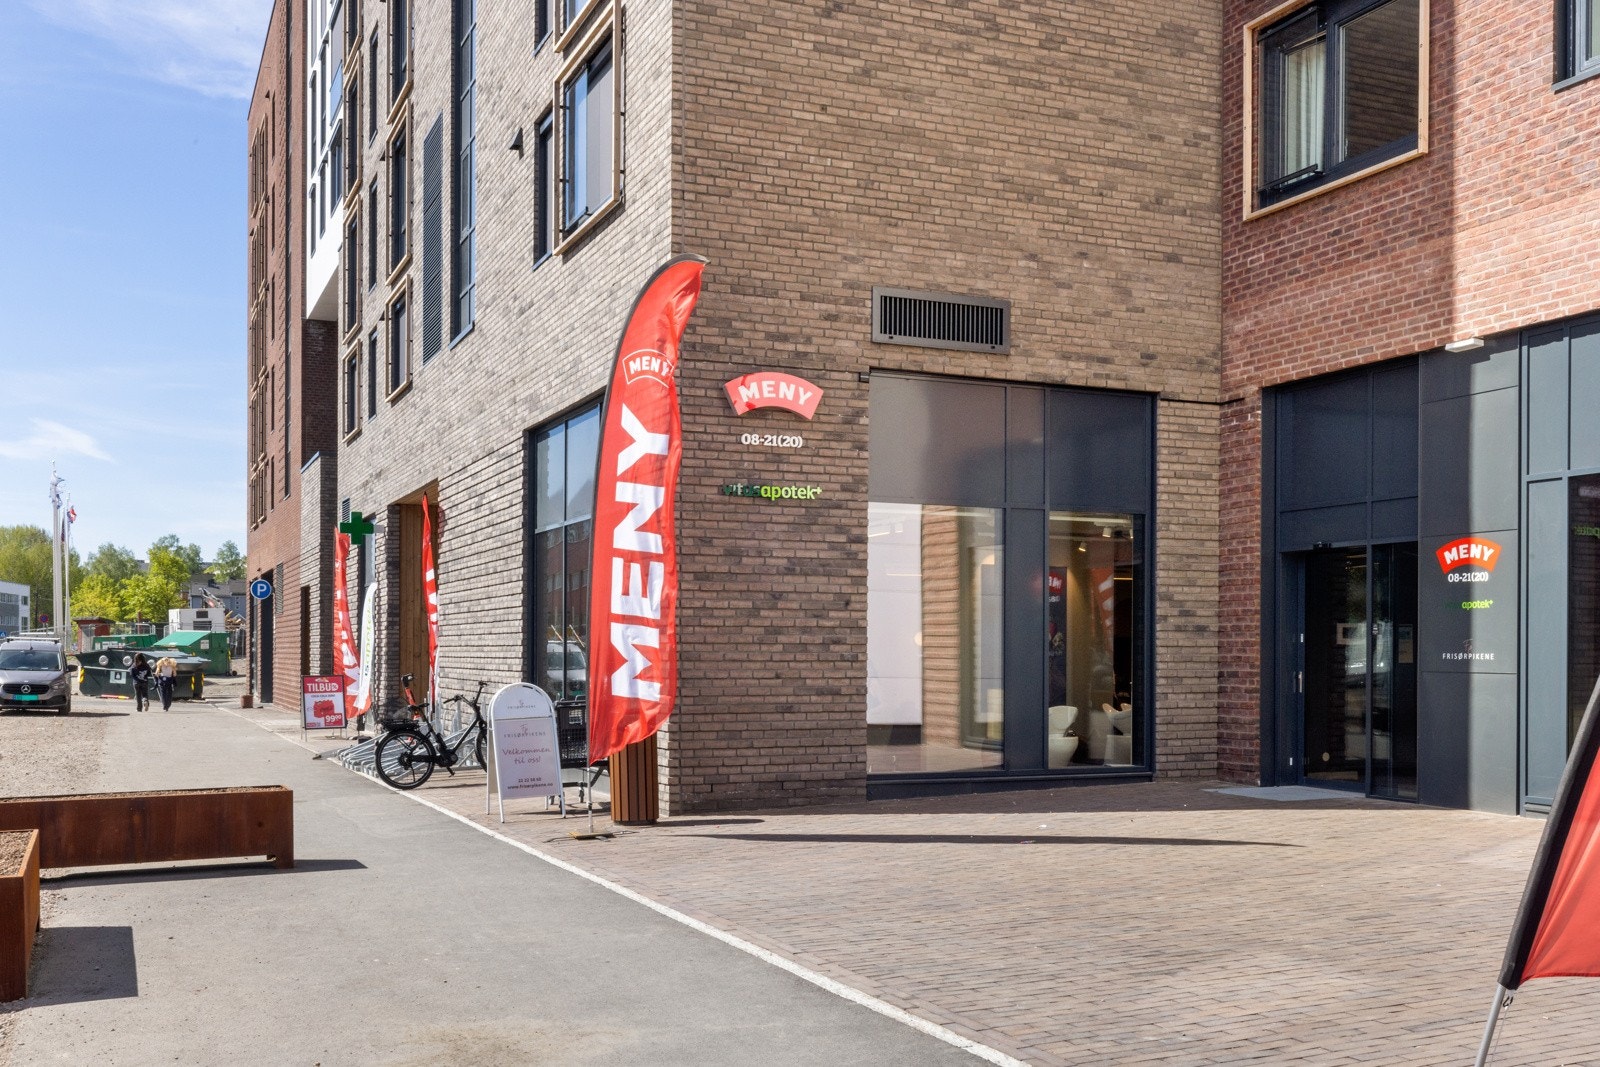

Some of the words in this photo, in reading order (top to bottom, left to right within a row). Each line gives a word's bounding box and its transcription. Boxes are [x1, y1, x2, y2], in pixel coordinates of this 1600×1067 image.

[629, 355, 671, 376] MENY
[738, 380, 813, 405] MENY
[741, 433, 803, 448] 08-21(20)
[610, 402, 670, 702] MENY
[1443, 543, 1495, 565] MENY
[1447, 571, 1489, 583] 08-21(20)
[257, 583, 267, 596] P
[1442, 652, 1495, 660] FRISØRPIKENE
[306, 682, 339, 692] TILBUD
[502, 747, 552, 756] Velkommen
